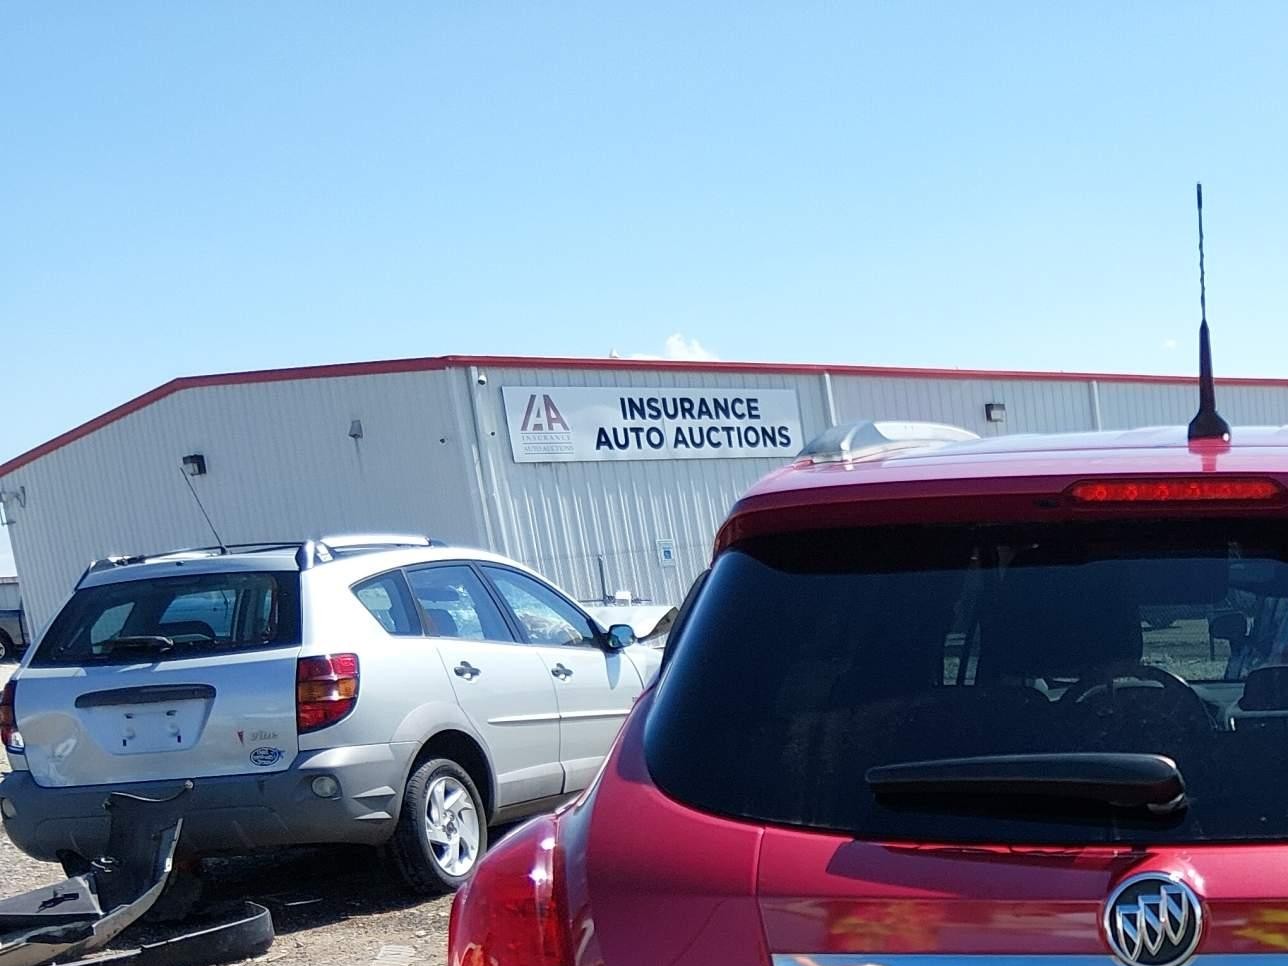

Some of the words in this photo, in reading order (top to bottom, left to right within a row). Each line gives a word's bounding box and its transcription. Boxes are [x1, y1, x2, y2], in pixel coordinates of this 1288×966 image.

[619, 397, 761, 421] INSURANCE
[595, 426, 665, 450] AUTO
[673, 425, 792, 449] AUCTIONS
